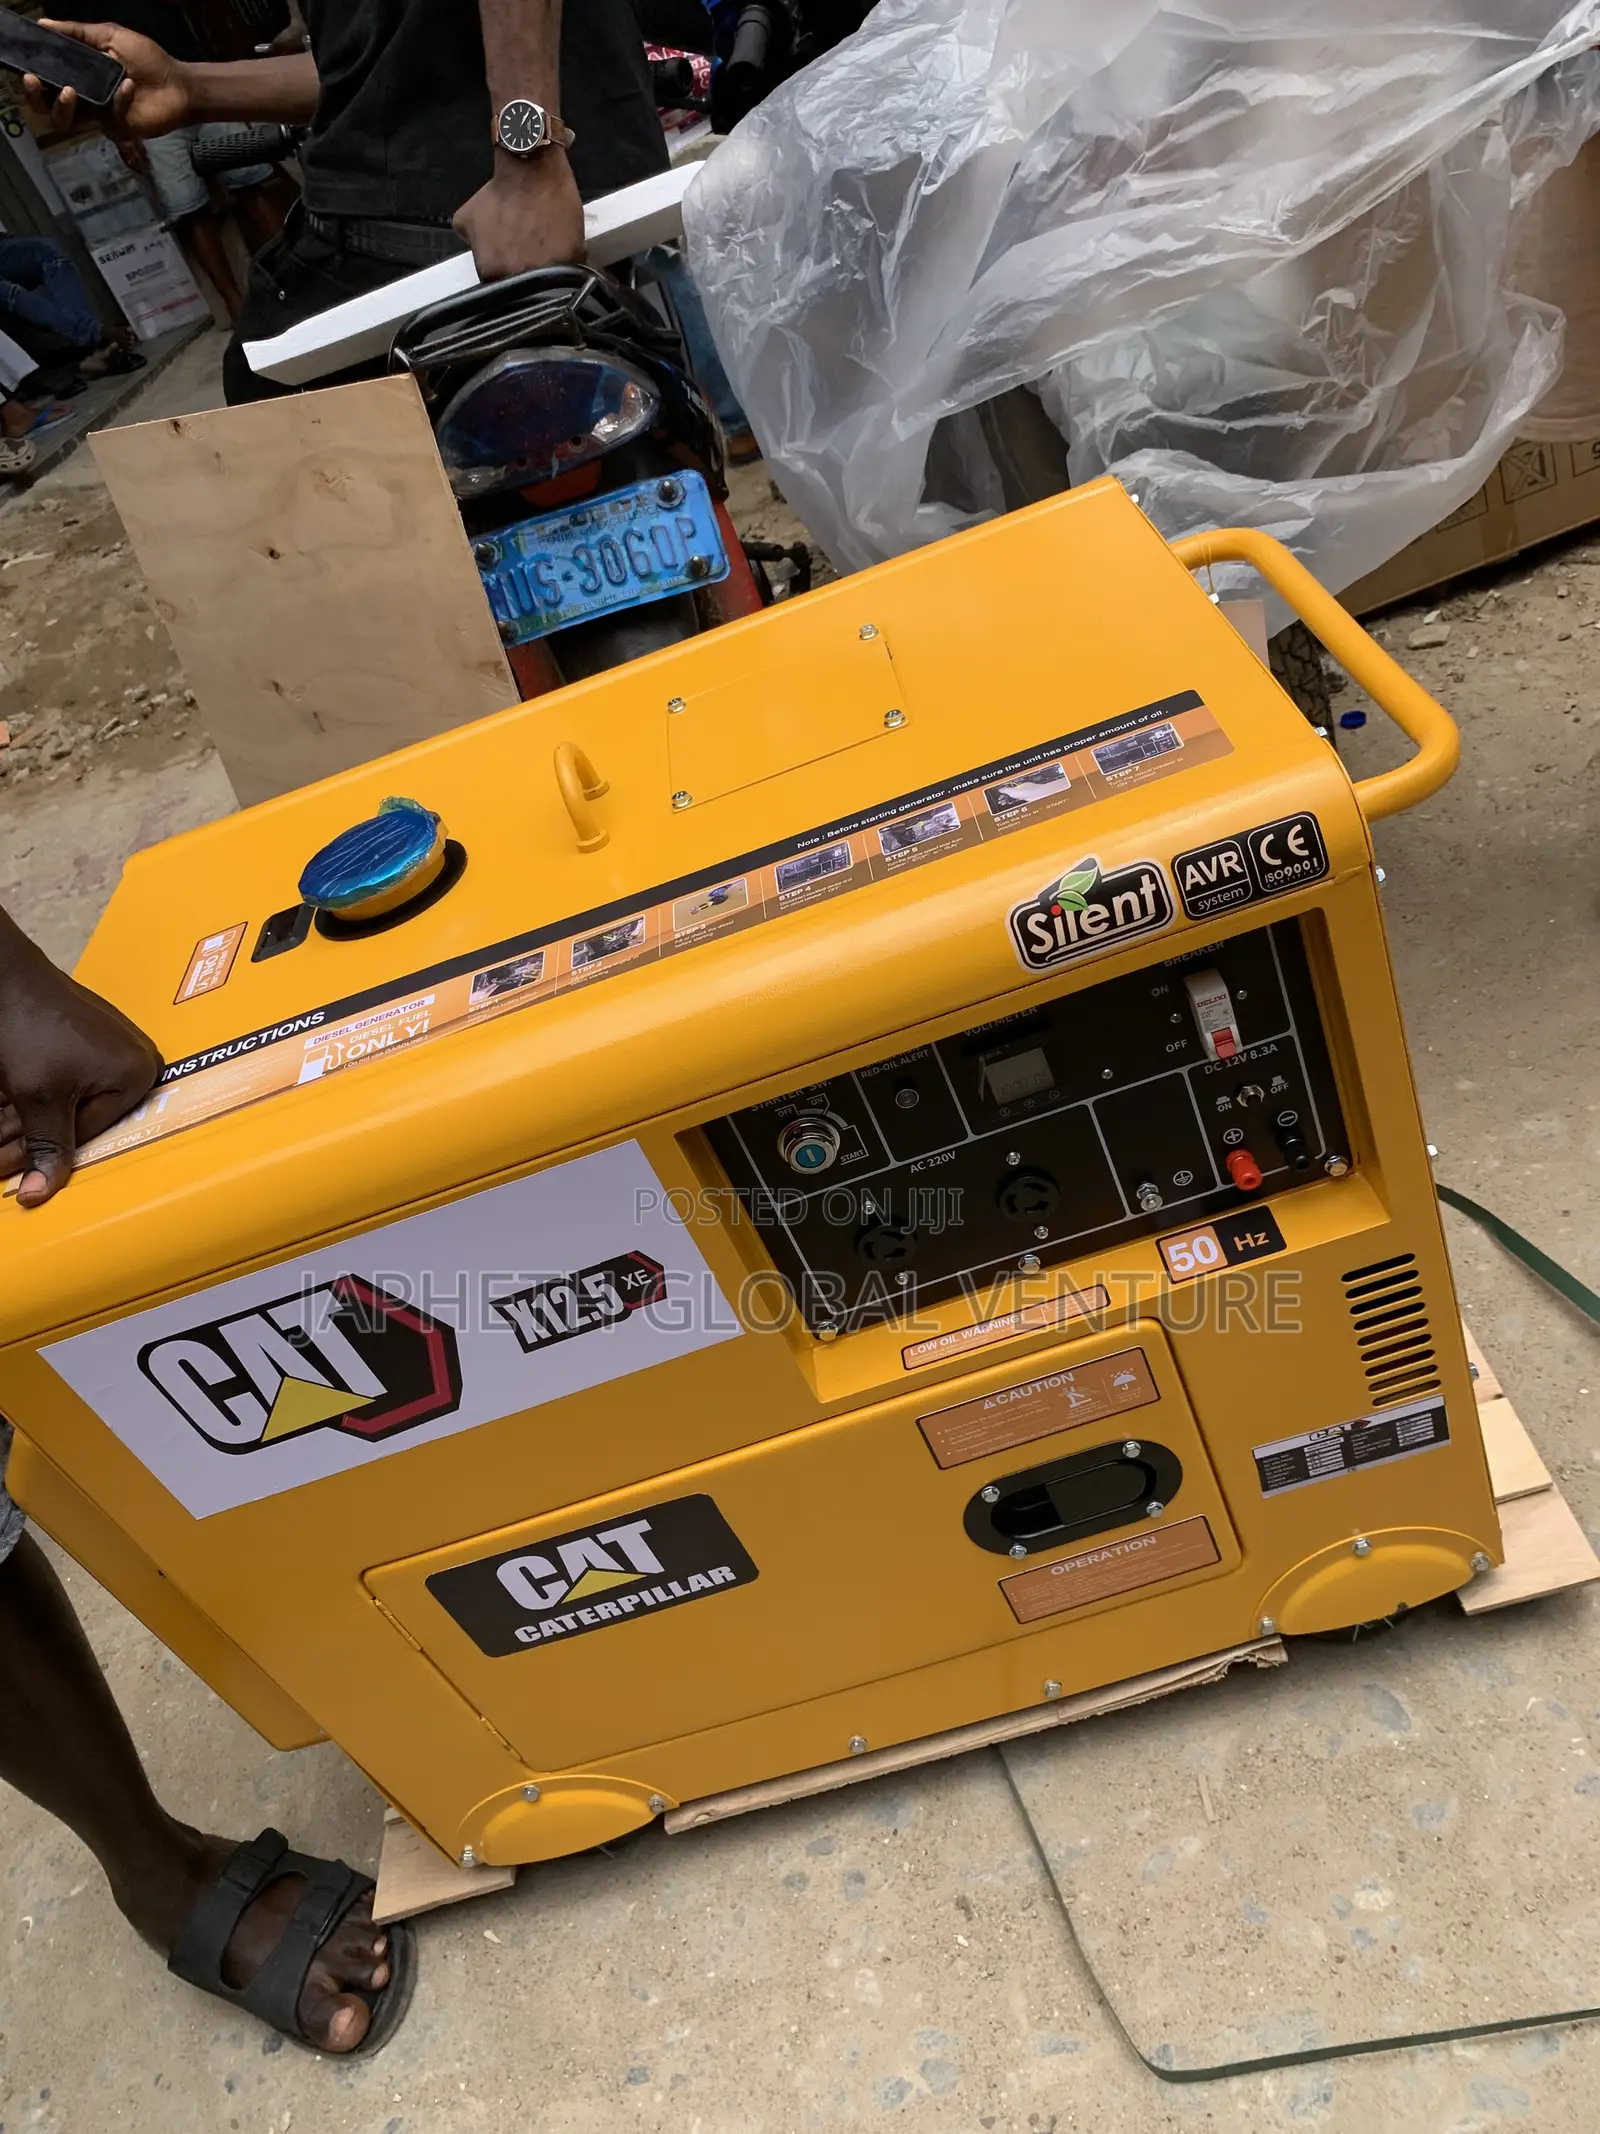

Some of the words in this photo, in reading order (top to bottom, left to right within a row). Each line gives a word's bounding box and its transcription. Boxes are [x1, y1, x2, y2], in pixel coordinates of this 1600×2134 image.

[797, 836, 821, 850] Note
[827, 821, 860, 839] Before
[861, 808, 897, 827] starting
[898, 789, 946, 813] generator
[953, 776, 980, 793] make
[981, 767, 1004, 782] sure
[1005, 760, 1022, 774] the
[1023, 753, 1042, 767] unit
[1043, 746, 1062, 759] has
[1063, 735, 1098, 752] proper
[1099, 719, 1137, 739] amount
[1138, 714, 1149, 724] of
[1151, 709, 1163, 720] oil
[1105, 768, 1132, 782] STEP
[993, 808, 1020, 823] STEP
[885, 849, 911, 863] STEP
[1185, 850, 1244, 892] AVR
[1264, 857, 1319, 884] ISO9001
[778, 888, 804, 901] STEP
[1197, 886, 1245, 911] system
[1028, 873, 1158, 956] Silent
[571, 963, 595, 977] STEP
[1151, 984, 1170, 998] ON
[1196, 993, 1227, 1008] DELIXI
[313, 1026, 352, 1045] DIESEL
[354, 999, 426, 1030] GENERATOR
[349, 1023, 395, 1044] DIESEL
[397, 1010, 432, 1027] FUEL
[161, 1011, 326, 1082] INSTRUCTIONS
[1165, 1038, 1189, 1053] OFF
[860, 1059, 900, 1080] RED-OIL
[900, 1048, 930, 1065] ALERT
[1204, 1062, 1223, 1076] DC
[1225, 1053, 1249, 1069] 12V
[1249, 1043, 1279, 1060] 8.3A
[810, 1096, 824, 1106] ON
[1270, 1081, 1290, 1095] OFF
[777, 1108, 793, 1118] OFF
[1217, 1101, 1233, 1113] ON
[840, 1149, 865, 1164] START
[909, 1159, 927, 1174] AC
[928, 1149, 958, 1168] 220V
[1167, 1235, 1219, 1273] 50
[1232, 1231, 1271, 1252] Hz
[501, 1271, 625, 1346] X12.5
[620, 1268, 653, 1292] XE
[909, 1340, 938, 1358] LOW
[939, 1334, 959, 1347] OIL
[960, 1311, 1025, 1341] WARNING!
[147, 1289, 388, 1446] CAT
[994, 1371, 1076, 1406] CAUTION
[496, 1518, 666, 1612] CAT
[1049, 1534, 1158, 1577] OPERATION
[513, 1565, 737, 1644] CATERPILLAR
